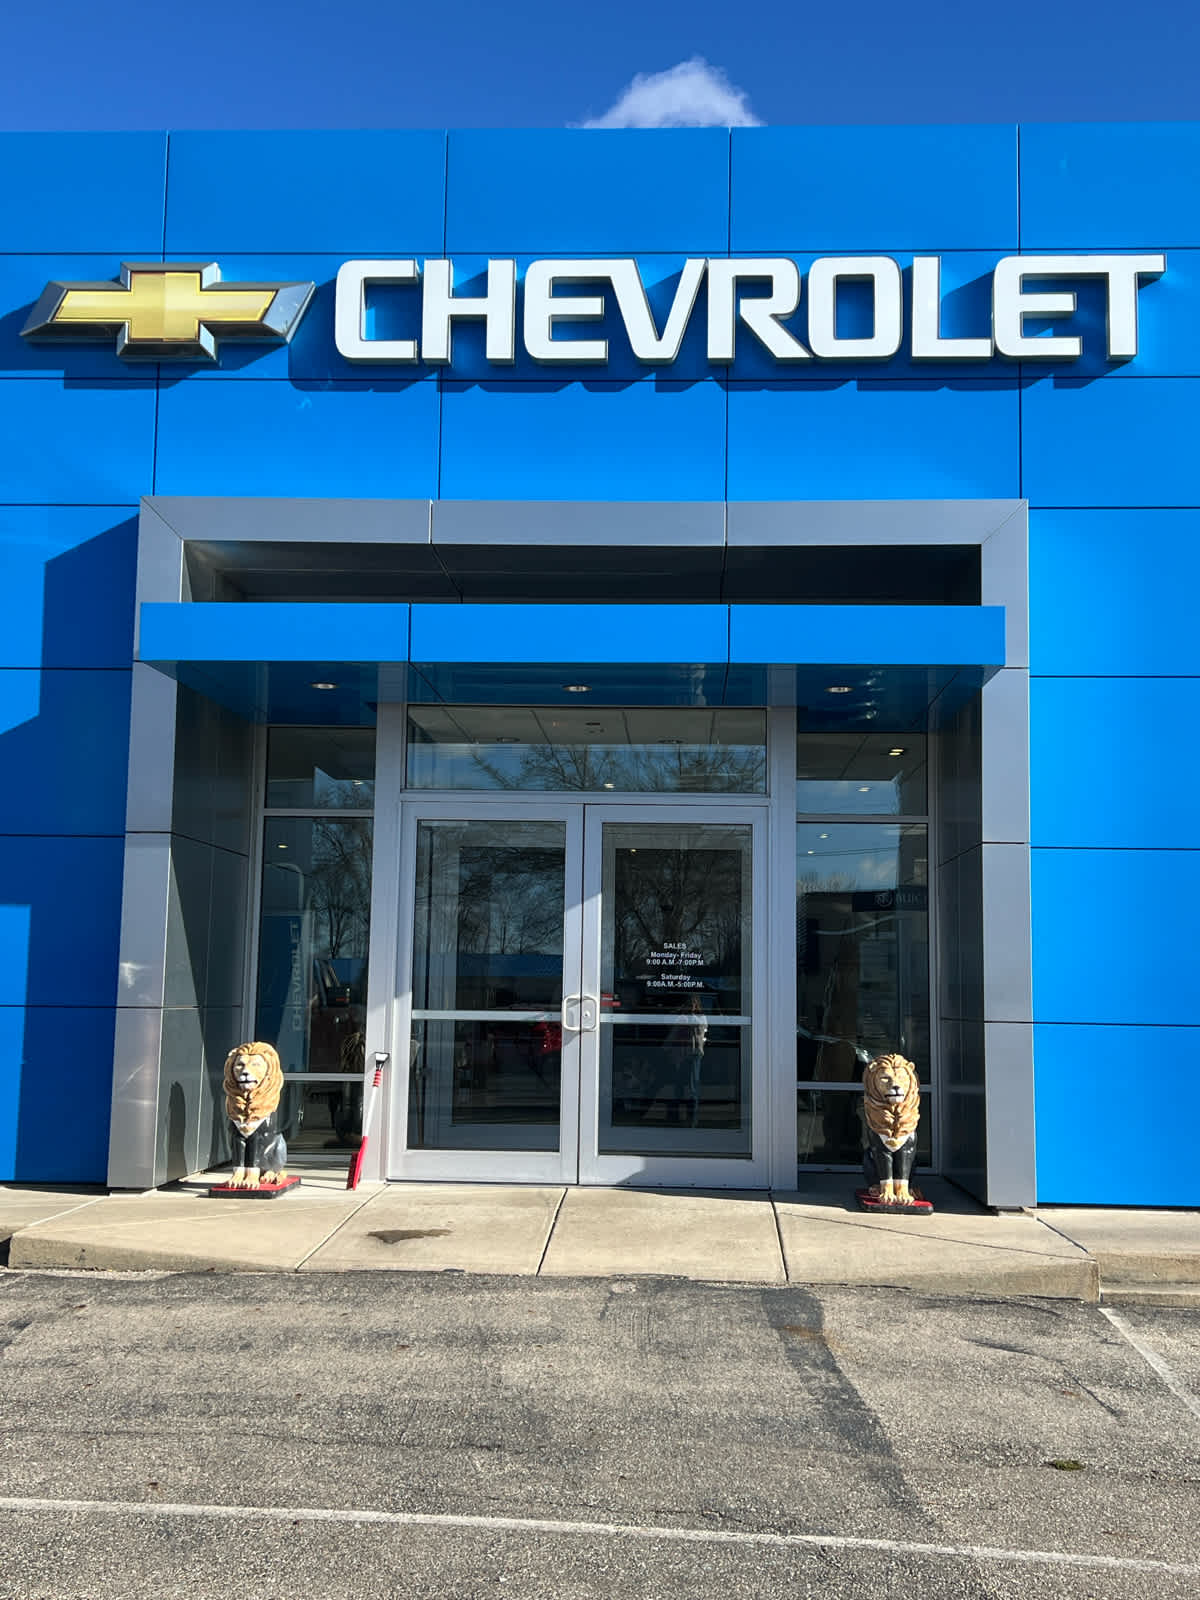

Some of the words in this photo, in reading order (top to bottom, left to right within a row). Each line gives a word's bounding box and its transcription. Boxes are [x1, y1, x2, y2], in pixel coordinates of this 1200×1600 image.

[335, 253, 1167, 363] CHEVROLET
[663, 942, 687, 950] SALES
[680, 952, 702, 960] Friday
[660, 973, 691, 981] Saturday
